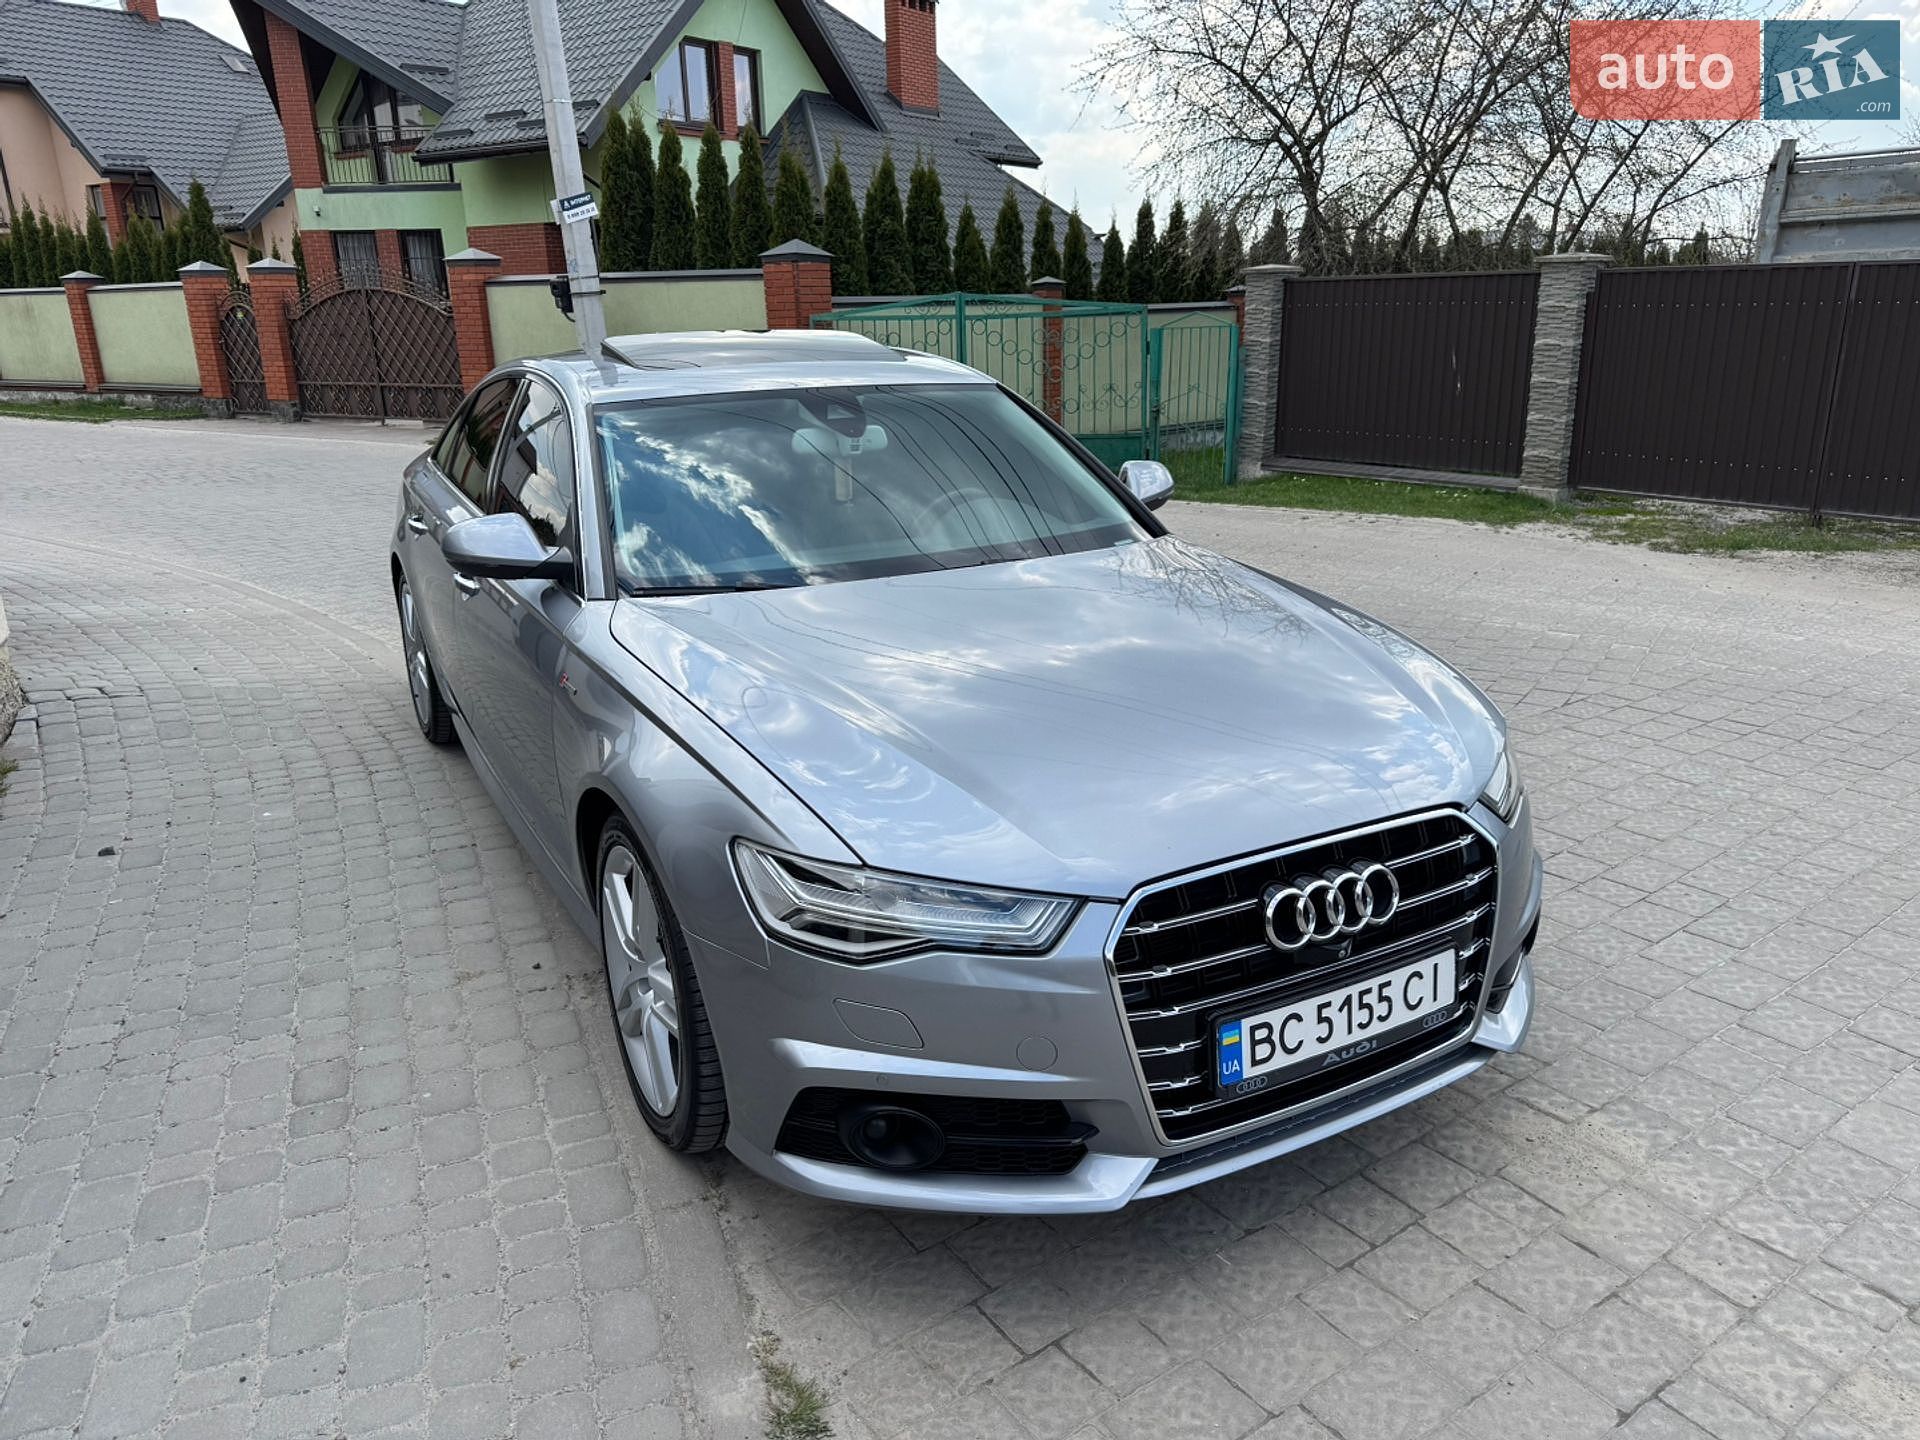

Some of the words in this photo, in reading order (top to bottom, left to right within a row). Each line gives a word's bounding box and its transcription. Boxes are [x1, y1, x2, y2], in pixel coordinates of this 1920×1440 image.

[1249, 1012, 1304, 1068] BC
[1316, 979, 1393, 1044] 5155
[1403, 962, 1439, 1011] CI
[1222, 1059, 1241, 1075] UA
[1322, 1039, 1378, 1067] Audi
